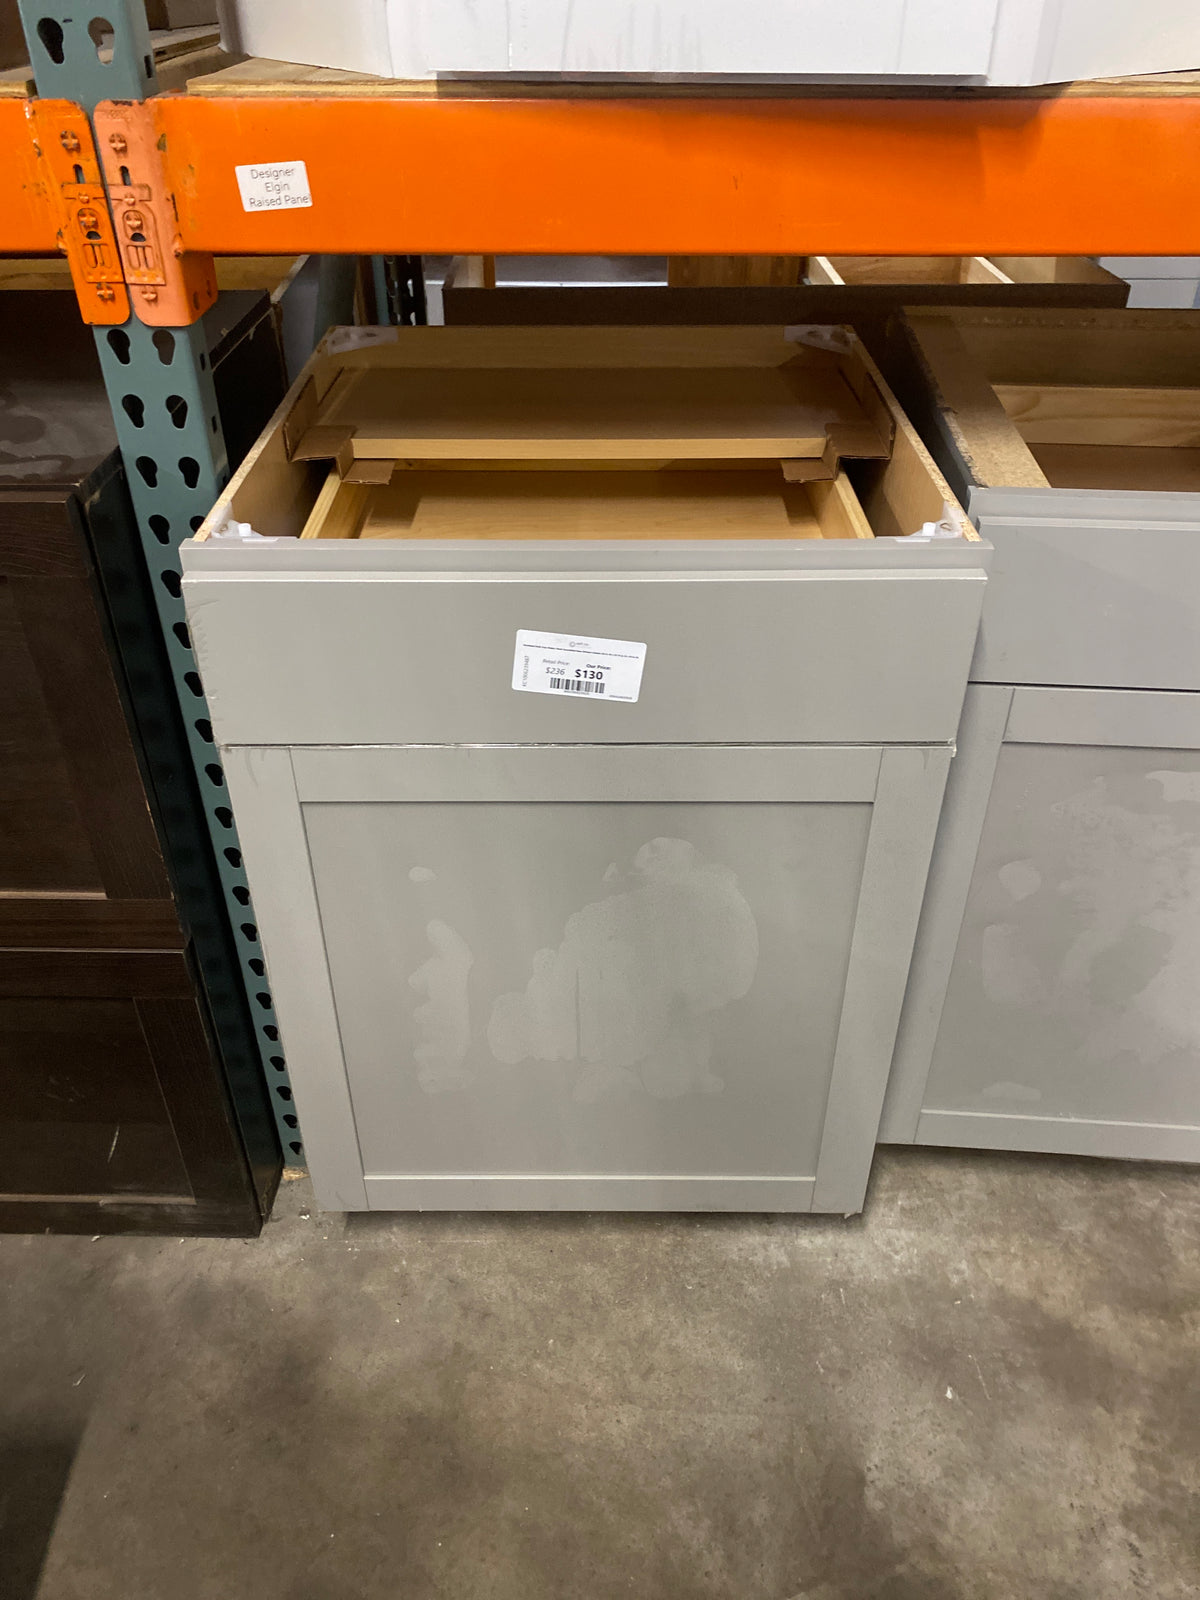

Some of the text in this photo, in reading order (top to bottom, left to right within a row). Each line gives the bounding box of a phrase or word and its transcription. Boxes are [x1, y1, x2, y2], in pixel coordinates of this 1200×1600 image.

[250, 167, 295, 180] Designer
[264, 182, 290, 194] Elgin
[249, 196, 282, 207] Raised
[545, 666, 566, 676] $236
[575, 669, 603, 680] $130
